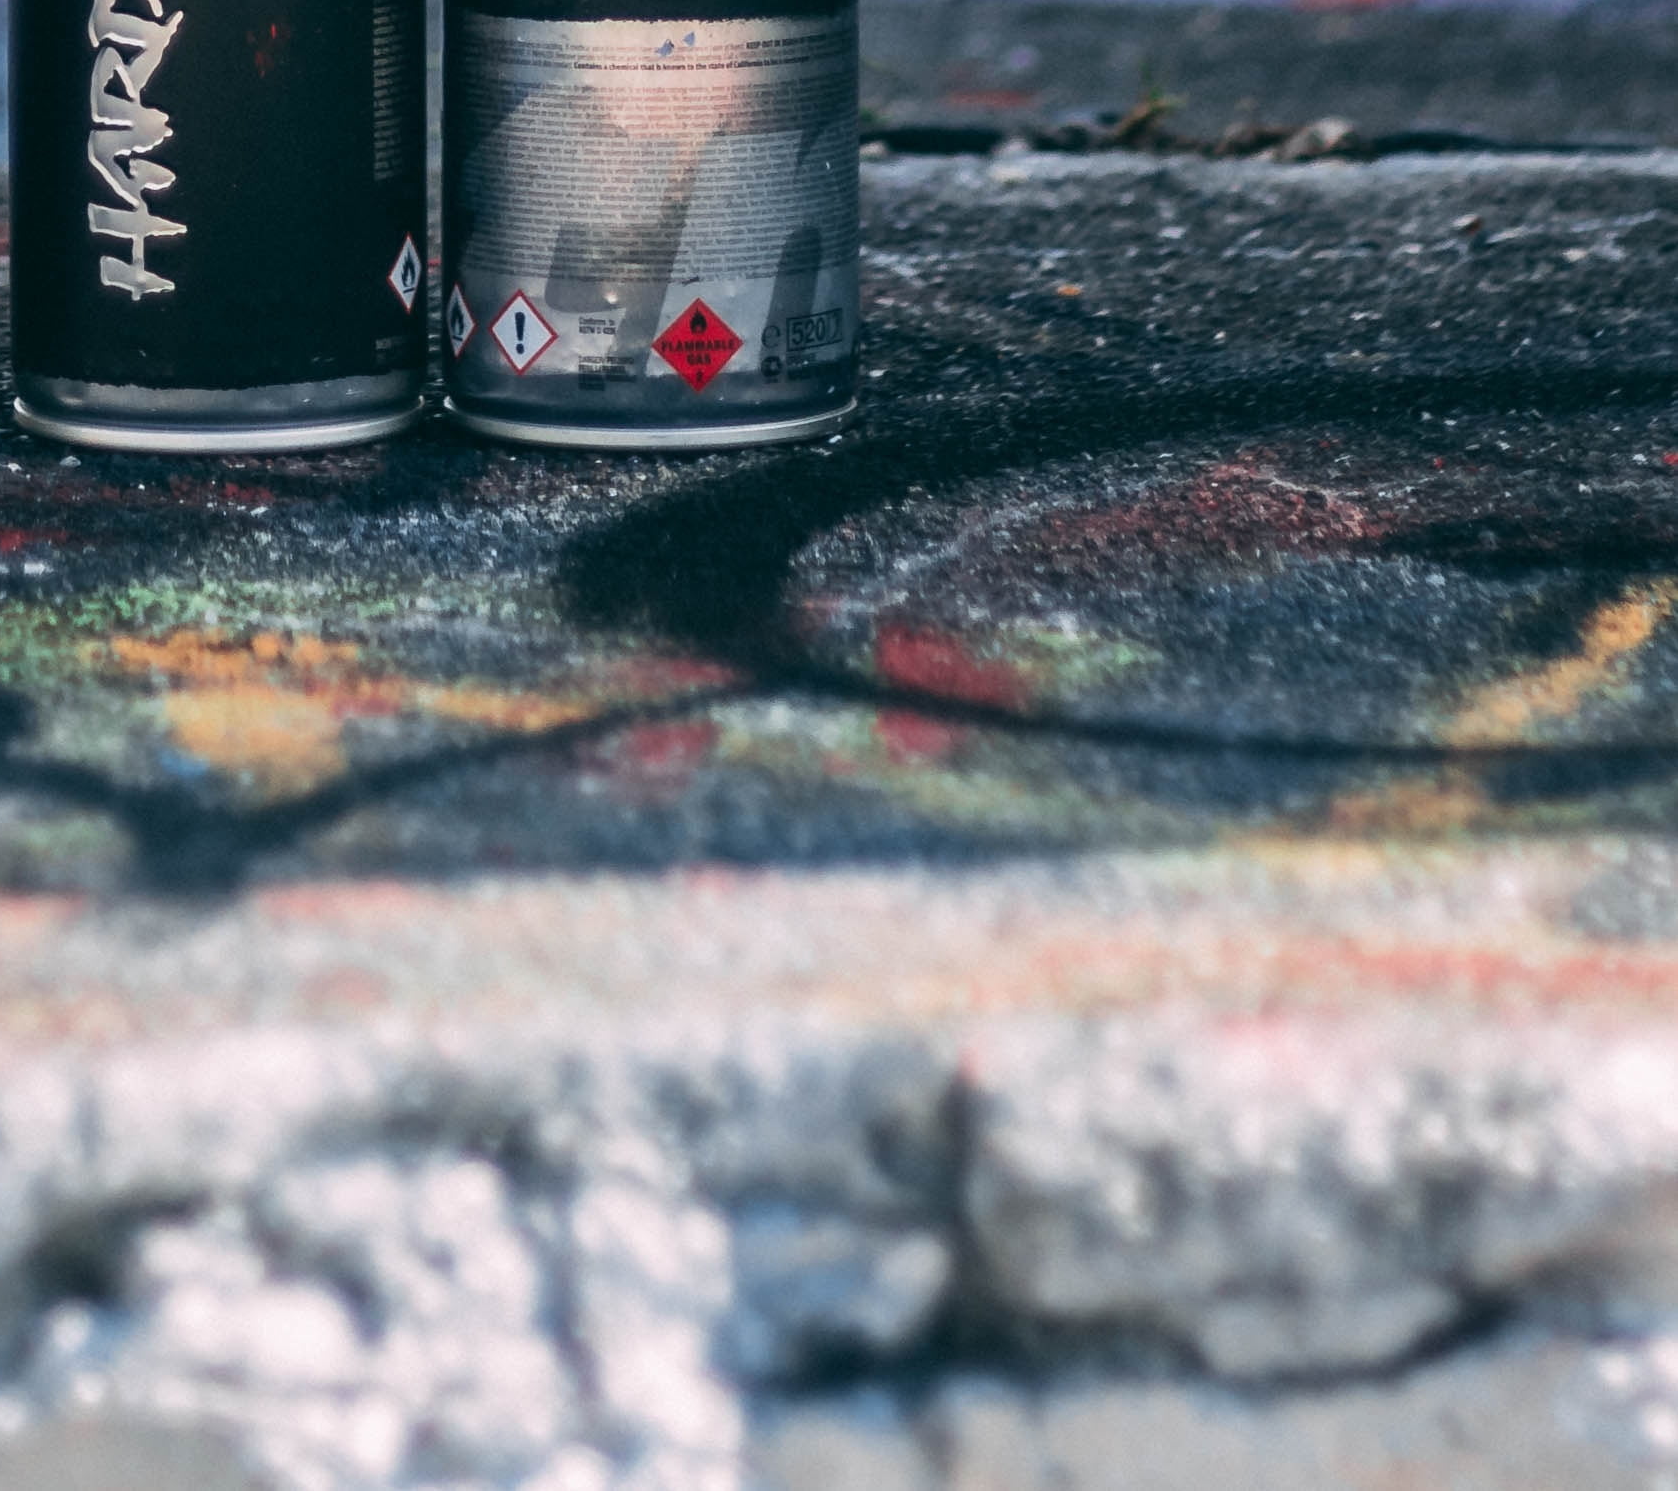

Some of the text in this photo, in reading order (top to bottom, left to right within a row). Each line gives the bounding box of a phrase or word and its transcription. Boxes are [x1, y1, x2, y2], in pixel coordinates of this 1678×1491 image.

[640, 63, 655, 71] that
[663, 63, 685, 71] known
[708, 62, 725, 70] state
[726, 61, 733, 69] of
[661, 340, 735, 352] FLAMMABLE
[686, 354, 712, 366] GAS
